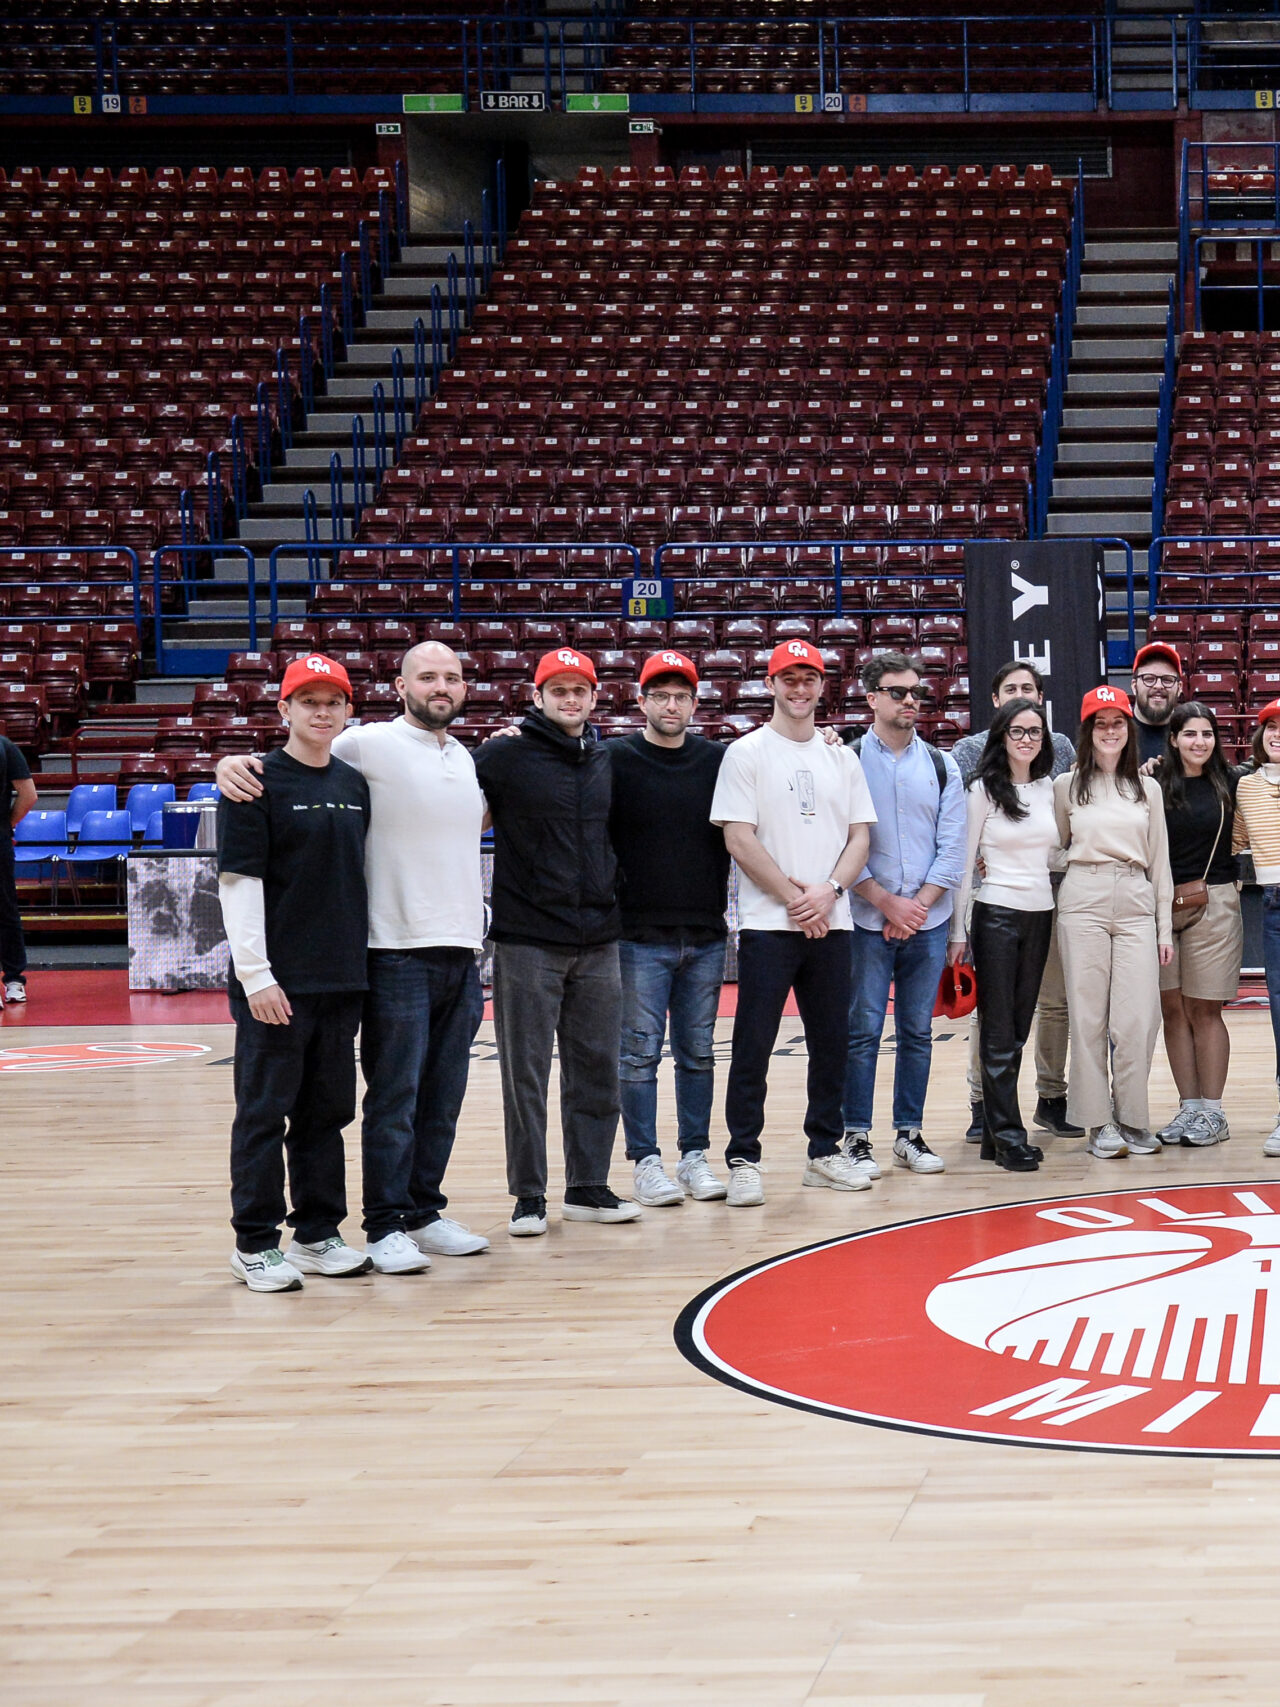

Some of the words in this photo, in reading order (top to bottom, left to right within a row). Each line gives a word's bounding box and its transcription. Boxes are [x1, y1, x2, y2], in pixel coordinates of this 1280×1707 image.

[103, 97, 119, 109] 19
[498, 95, 529, 108] BAR
[825, 96, 841, 109] 20
[637, 582, 658, 596] 20
[633, 605, 642, 615] B
